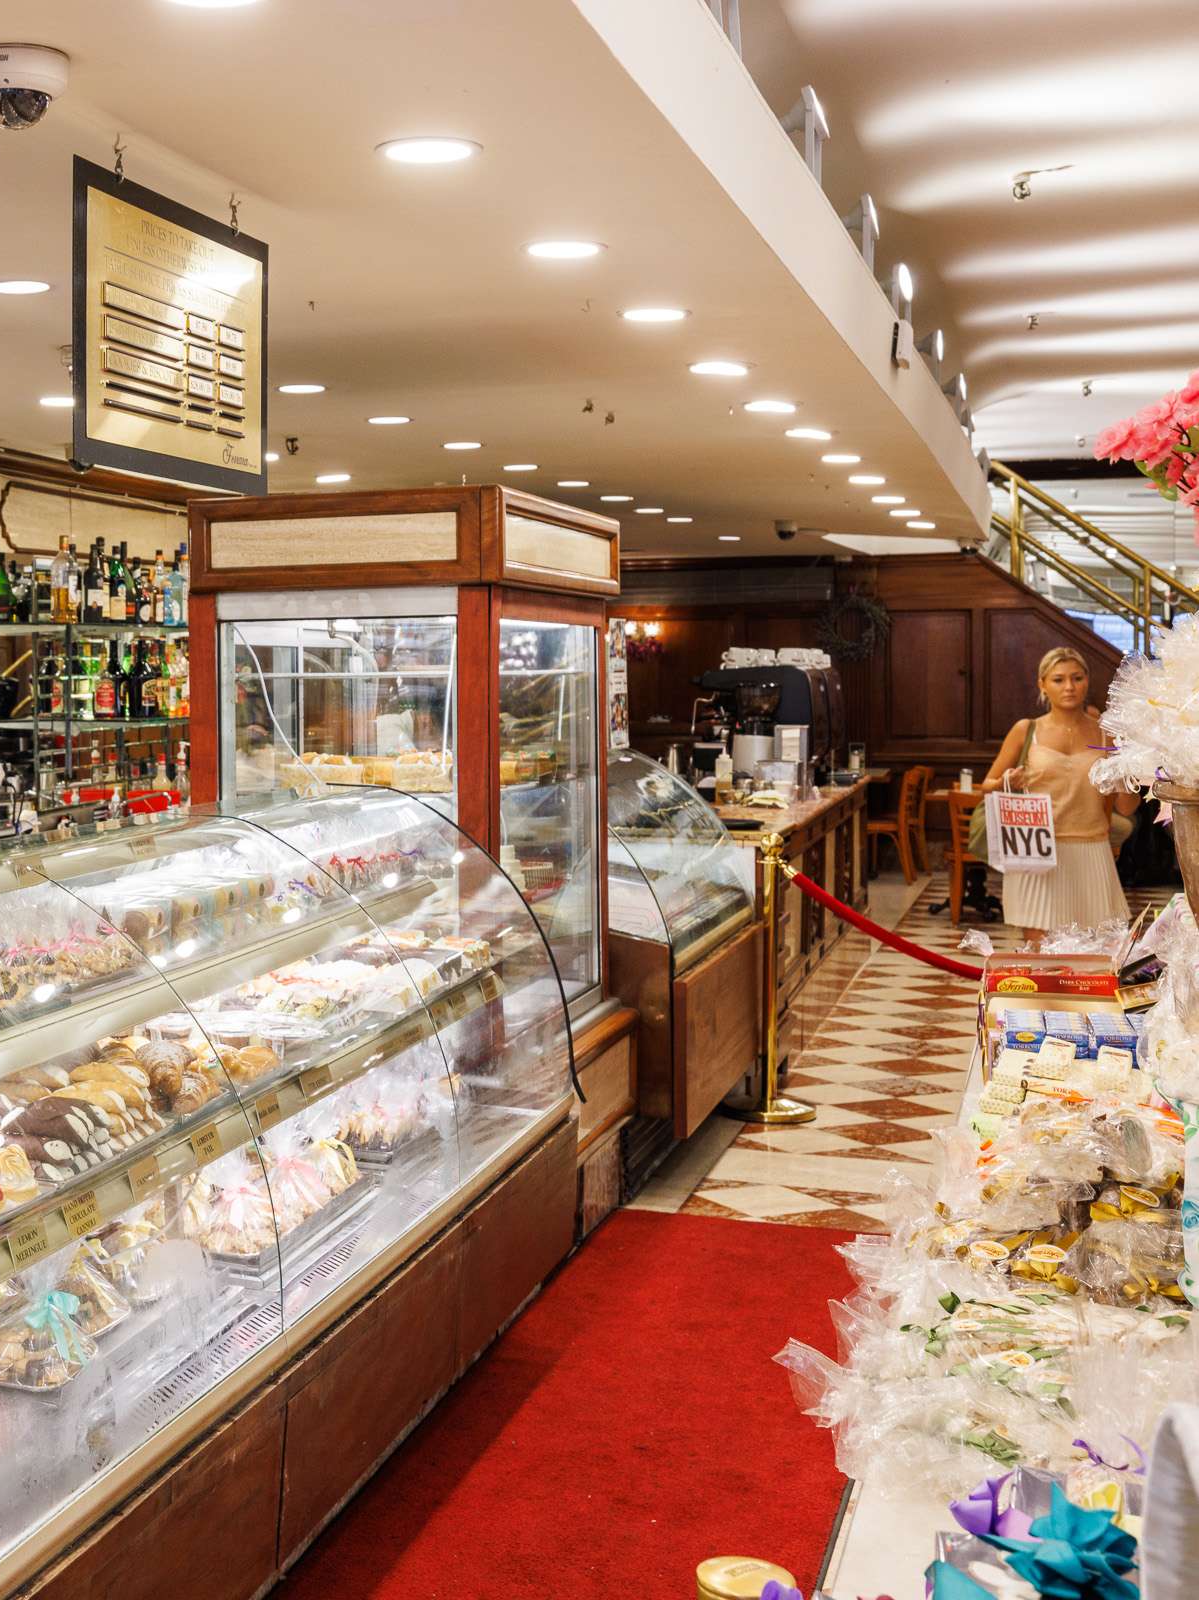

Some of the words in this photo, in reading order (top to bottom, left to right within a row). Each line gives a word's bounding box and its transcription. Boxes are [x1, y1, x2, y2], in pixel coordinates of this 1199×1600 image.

[1001, 826, 1052, 857] NYC
[18, 1227, 38, 1247] LEMON
[15, 1239, 47, 1262] MERINGUE
